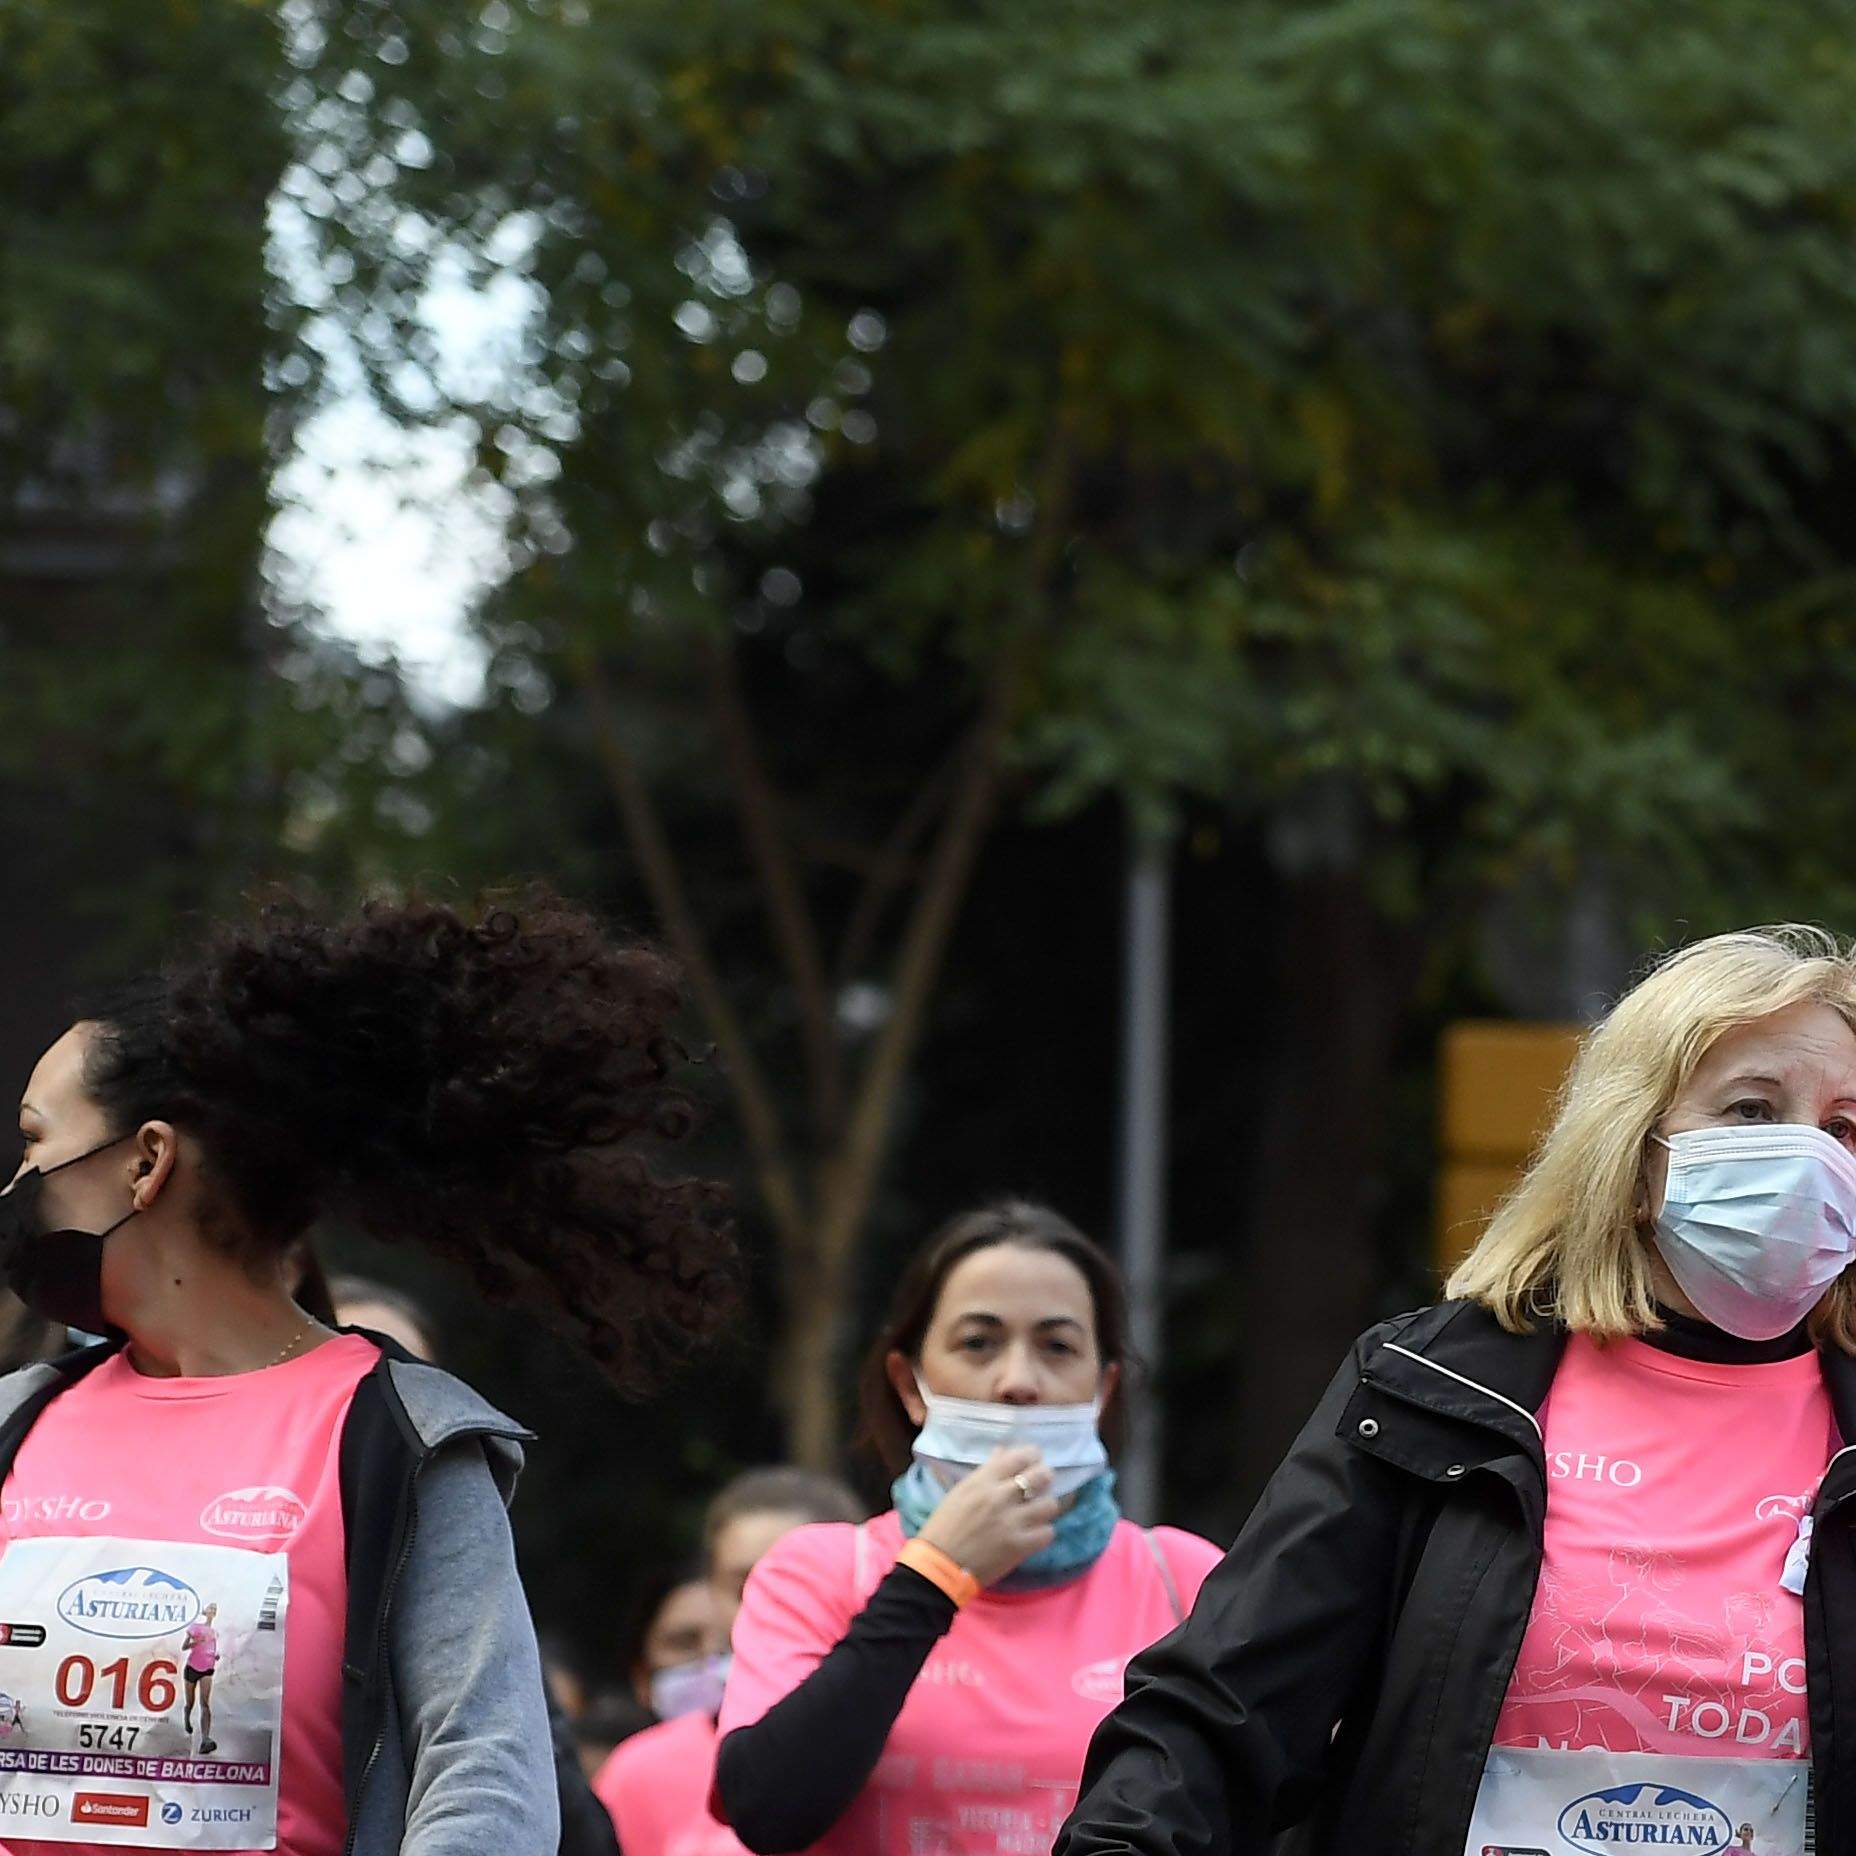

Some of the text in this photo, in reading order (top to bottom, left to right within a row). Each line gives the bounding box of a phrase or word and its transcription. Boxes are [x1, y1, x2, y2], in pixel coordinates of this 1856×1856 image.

[1546, 1452, 1642, 1487] SHO
[66, 1589, 187, 1622] ASTURIANA
[55, 1654, 178, 1712] 016
[80, 1724, 140, 1751] 5747
[28, 1754, 47, 1770] DE
[50, 1755, 79, 1772] LES
[83, 1758, 134, 1775] DONES
[137, 1760, 157, 1776] DE
[161, 1761, 265, 1782] BARCELONA
[91, 1802, 141, 1817] Santander
[191, 1808, 251, 1823] ZURICH
[1599, 1808, 1652, 1819] CENTRAL
[1571, 1809, 1720, 1846] ASTURIANA
